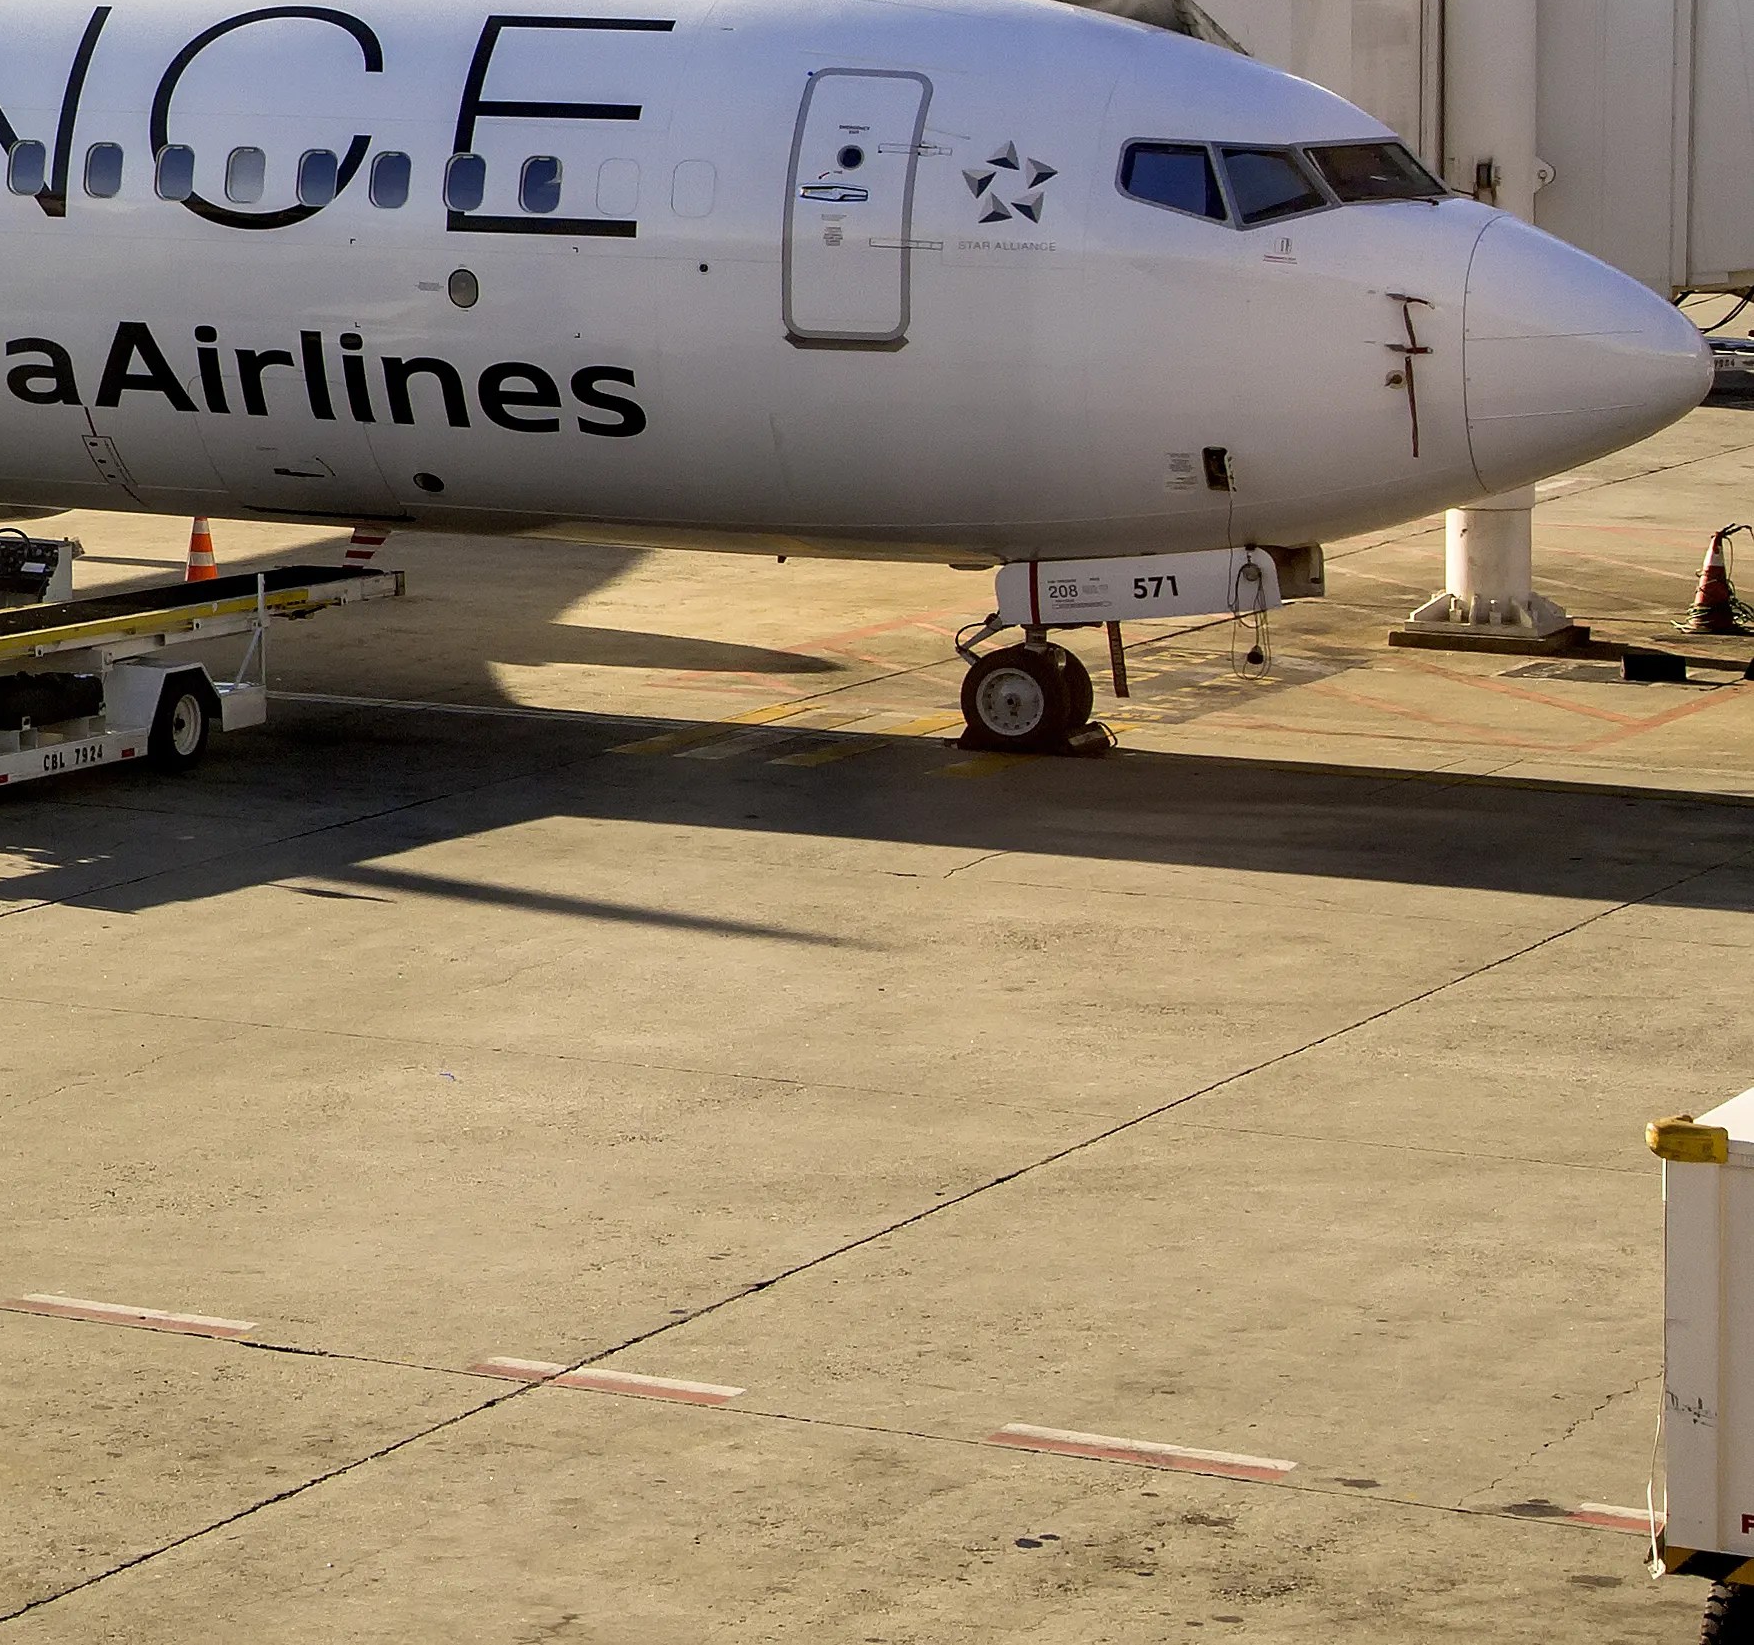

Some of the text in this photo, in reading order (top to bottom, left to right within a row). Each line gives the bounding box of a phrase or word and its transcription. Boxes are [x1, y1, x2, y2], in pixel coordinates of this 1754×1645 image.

[958, 240, 1056, 252] STAR ALLIANCE
[1048, 584, 1078, 598] 208
[1133, 575, 1179, 599] 571
[43, 743, 103, 771] CBL 7924
